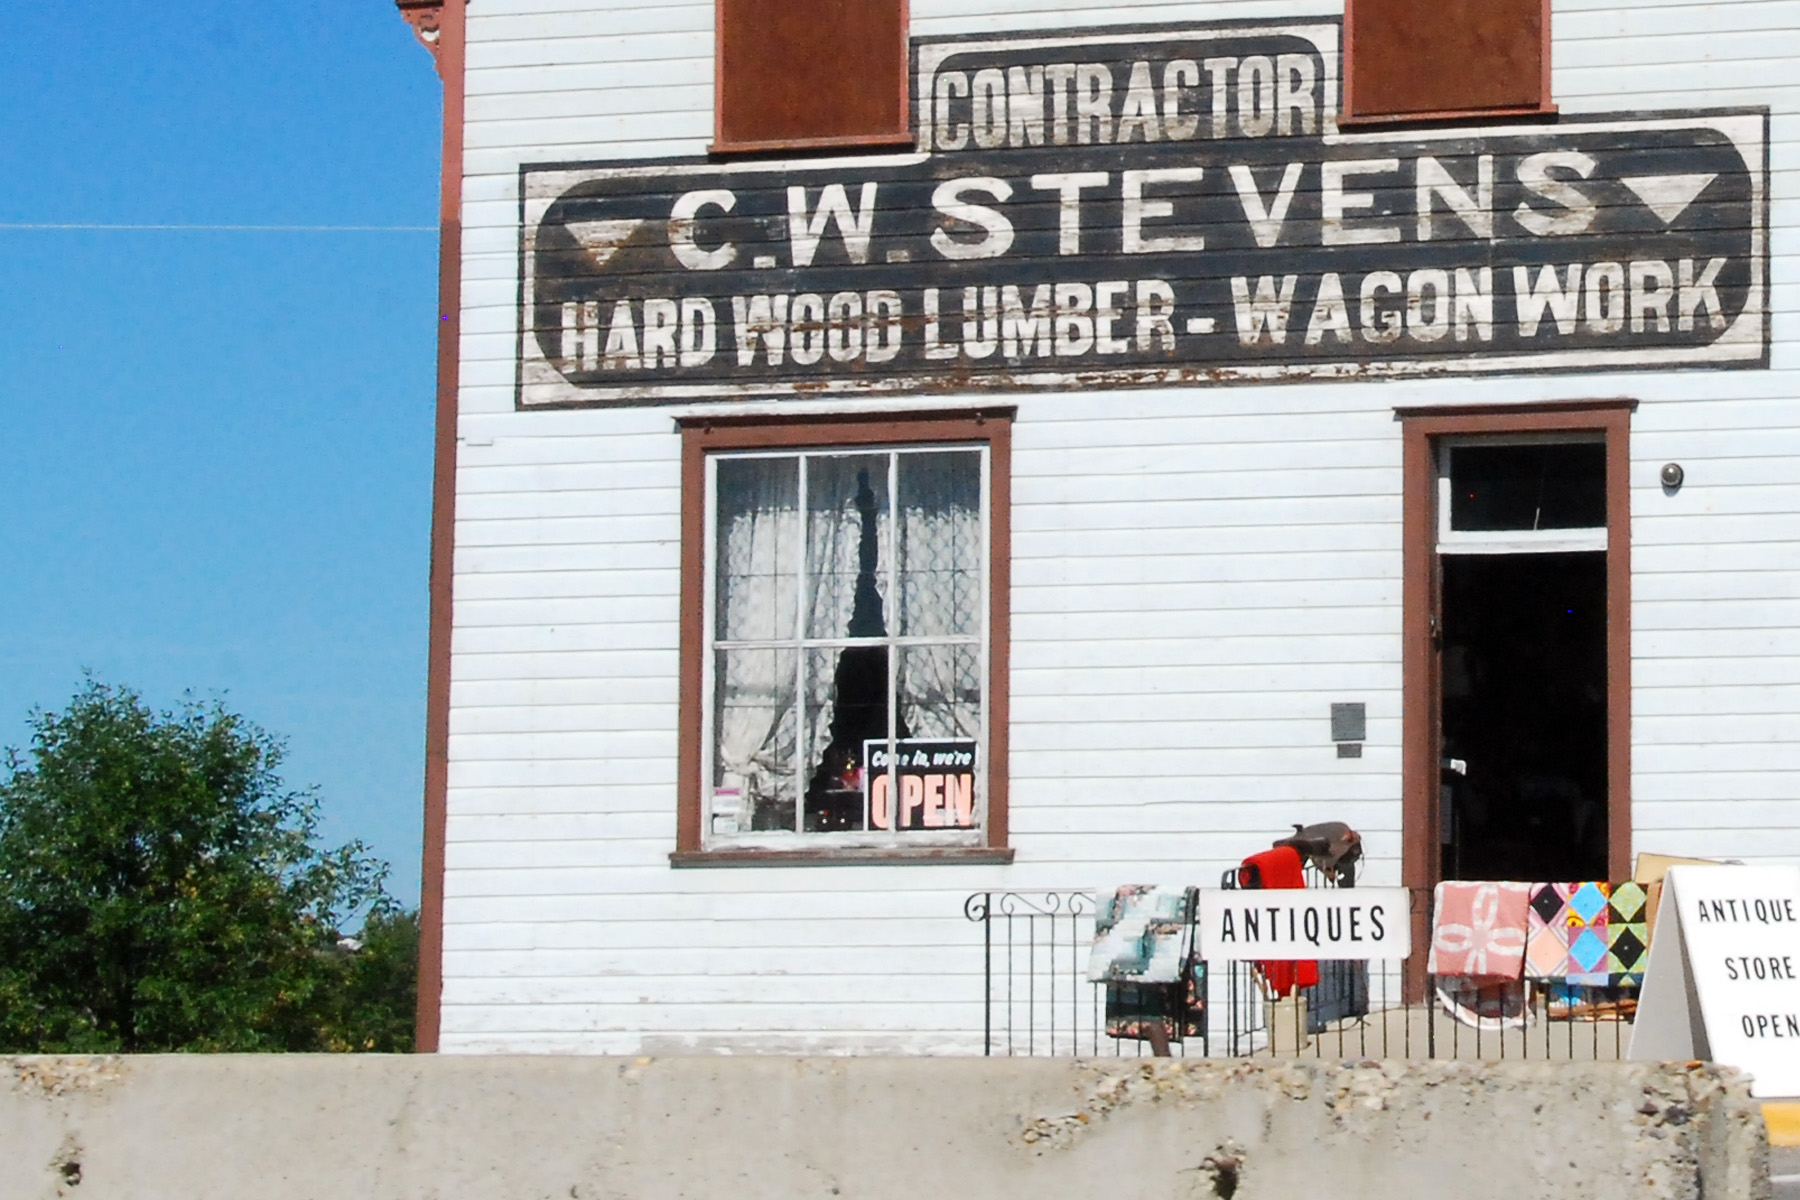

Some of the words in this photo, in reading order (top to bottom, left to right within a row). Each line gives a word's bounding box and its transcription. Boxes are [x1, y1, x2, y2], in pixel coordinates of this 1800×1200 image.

[936, 54, 1320, 151] CONTRACTOR
[930, 150, 1597, 260] STEVENS
[560, 297, 717, 374] HARD
[733, 289, 900, 366] WOOD
[924, 280, 1176, 360] LUMBER
[1231, 266, 1493, 347] WAGON
[1513, 256, 1727, 338] WORK
[872, 750, 910, 767] Coe
[871, 773, 972, 829] OPEN
[1222, 905, 1385, 947] ANTIQUES
[1699, 899, 1797, 923] ANTIQUE
[1725, 956, 1797, 981] STORE
[1741, 1013, 1800, 1039] OPEN
